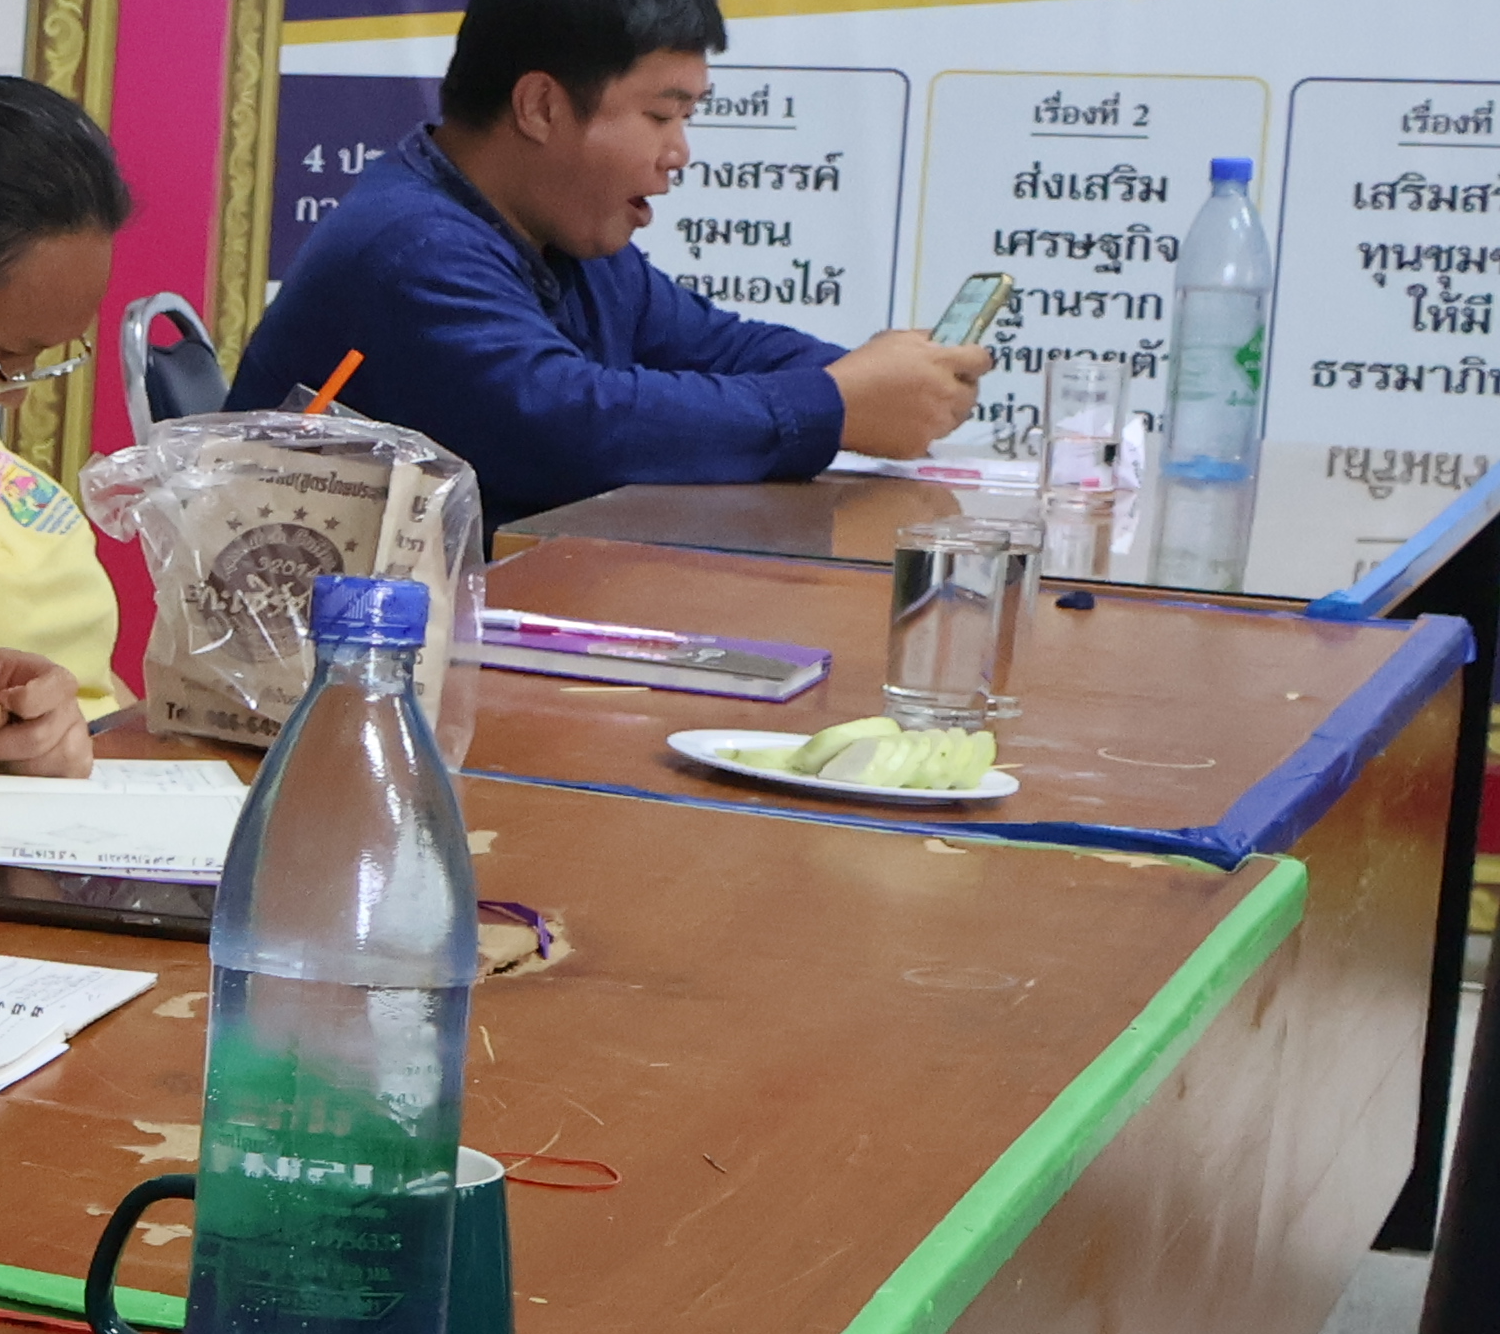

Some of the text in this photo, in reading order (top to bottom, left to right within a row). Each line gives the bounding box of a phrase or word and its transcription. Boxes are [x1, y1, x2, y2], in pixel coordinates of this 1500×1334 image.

[782, 95, 797, 119] 1
[1034, 89, 1151, 128] เรื่องที่ 2
[1401, 98, 1495, 135] เรื่องที่
[303, 142, 327, 174] 4
[1013, 159, 1169, 204] ส่งเสริม
[676, 216, 792, 260] ชุมชน
[993, 222, 1179, 274] เศรษฐกิจ
[674, 258, 846, 307] ตนเองได้
[996, 286, 1164, 329] ฐานราก
[1405, 282, 1494, 335] ให้มี
